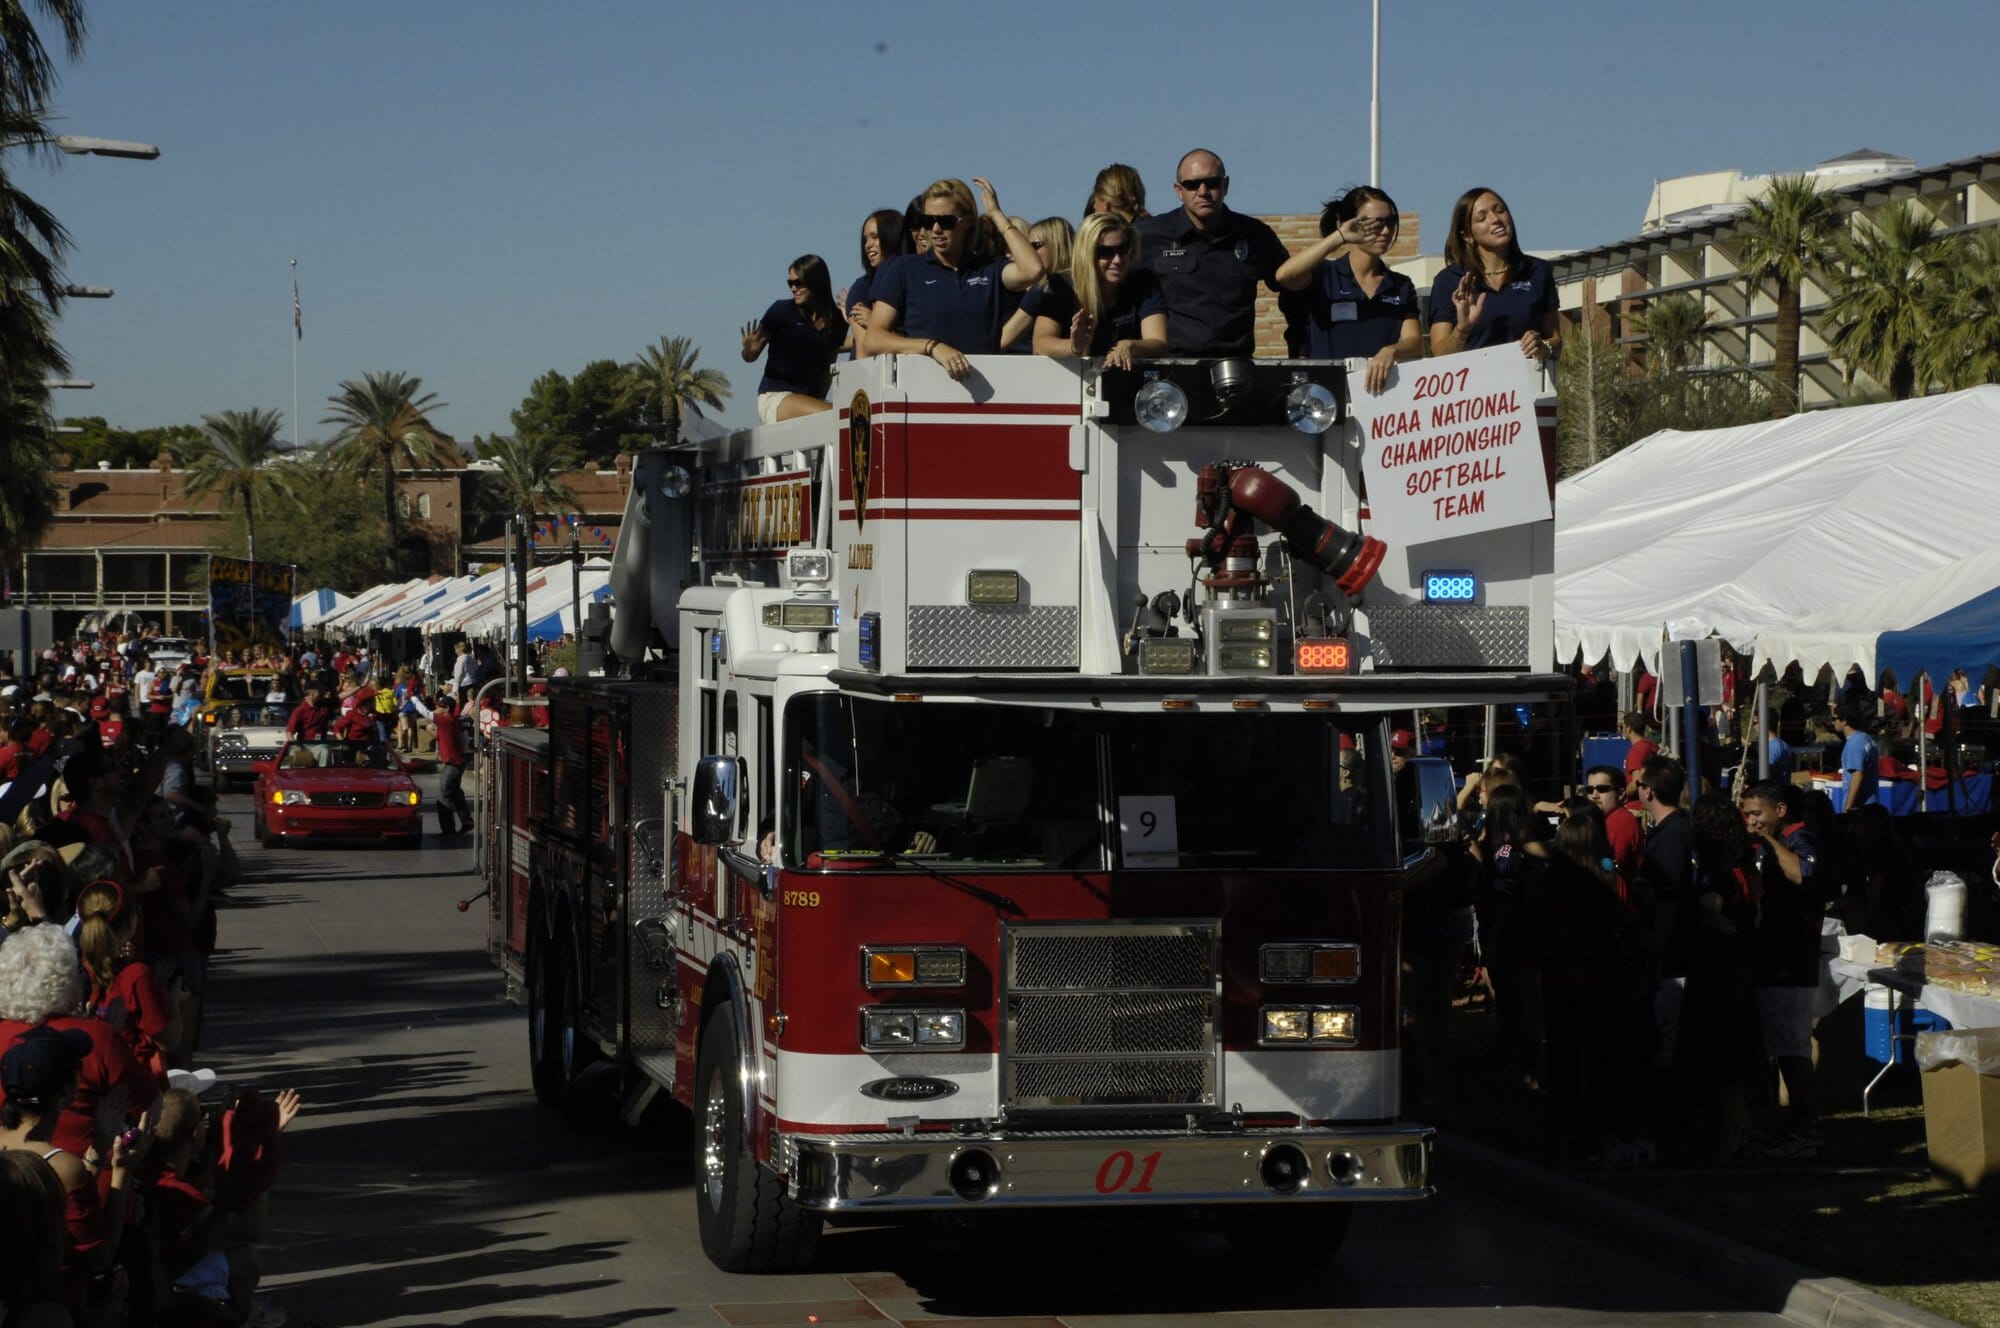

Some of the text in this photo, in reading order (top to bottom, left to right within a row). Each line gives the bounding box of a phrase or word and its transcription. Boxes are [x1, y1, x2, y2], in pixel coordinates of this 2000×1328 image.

[1413, 368, 1470, 401] 2007
[1371, 390, 1521, 440] NCAA NATIONAL
[1381, 421, 1522, 469] CHAMPIONSHIP
[1406, 456, 1506, 496] SOFTBALL
[764, 482, 802, 546] FIRE
[1433, 490, 1485, 521] TEAM
[1140, 811, 1157, 838] 9
[783, 890, 821, 908] 8789
[1095, 1150, 1163, 1195] 01
